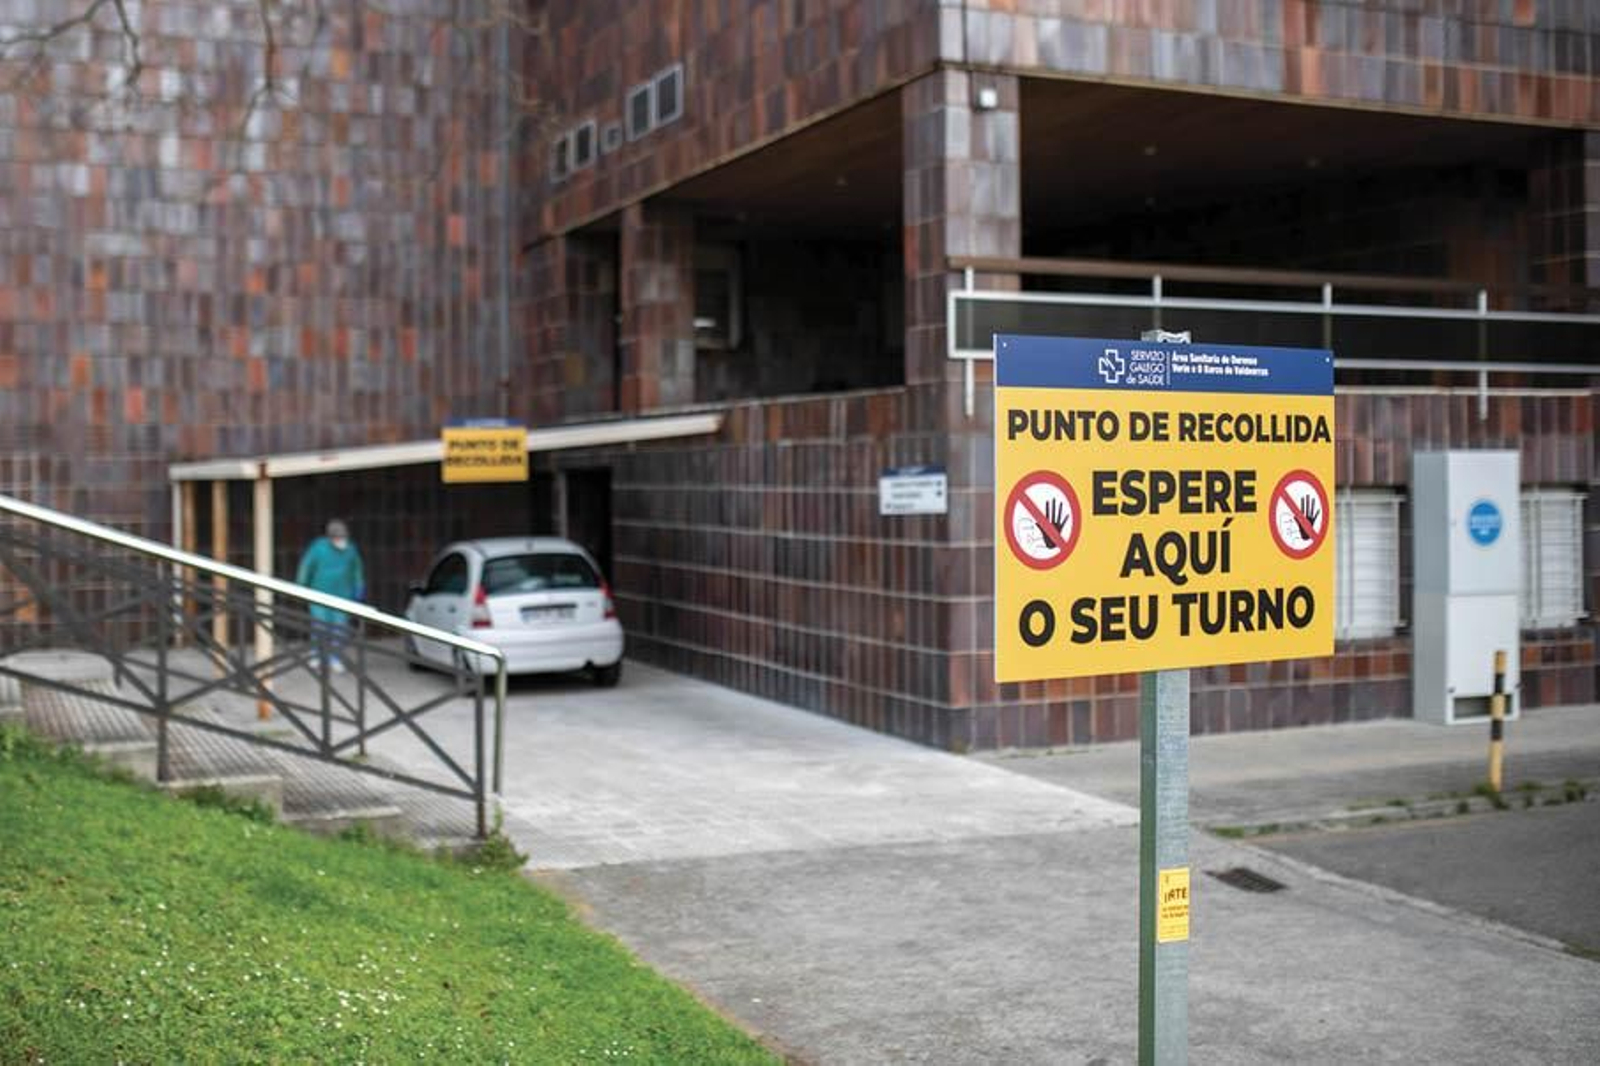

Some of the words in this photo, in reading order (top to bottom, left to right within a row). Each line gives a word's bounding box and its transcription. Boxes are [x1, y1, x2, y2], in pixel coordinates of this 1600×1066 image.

[1131, 350, 1165, 361] SERVIZO
[1172, 350, 1188, 362] Área
[1190, 353, 1220, 363] Sanitaria
[1221, 355, 1230, 364] de
[1231, 355, 1258, 366] Ourense
[1130, 362, 1165, 373] GALEGO
[1198, 364, 1203, 373] O
[1225, 366, 1233, 375] de
[1126, 373, 1137, 384] de
[1008, 409, 1120, 442] PUNTO
[1129, 411, 1170, 442] DE
[1178, 412, 1332, 443] RECOLLIDA
[1092, 469, 1257, 516] ESPERE
[1119, 517, 1234, 585] AQUÍ
[1019, 599, 1056, 647] O
[1070, 595, 1159, 645] SEU
[1171, 585, 1315, 637] TURNO
